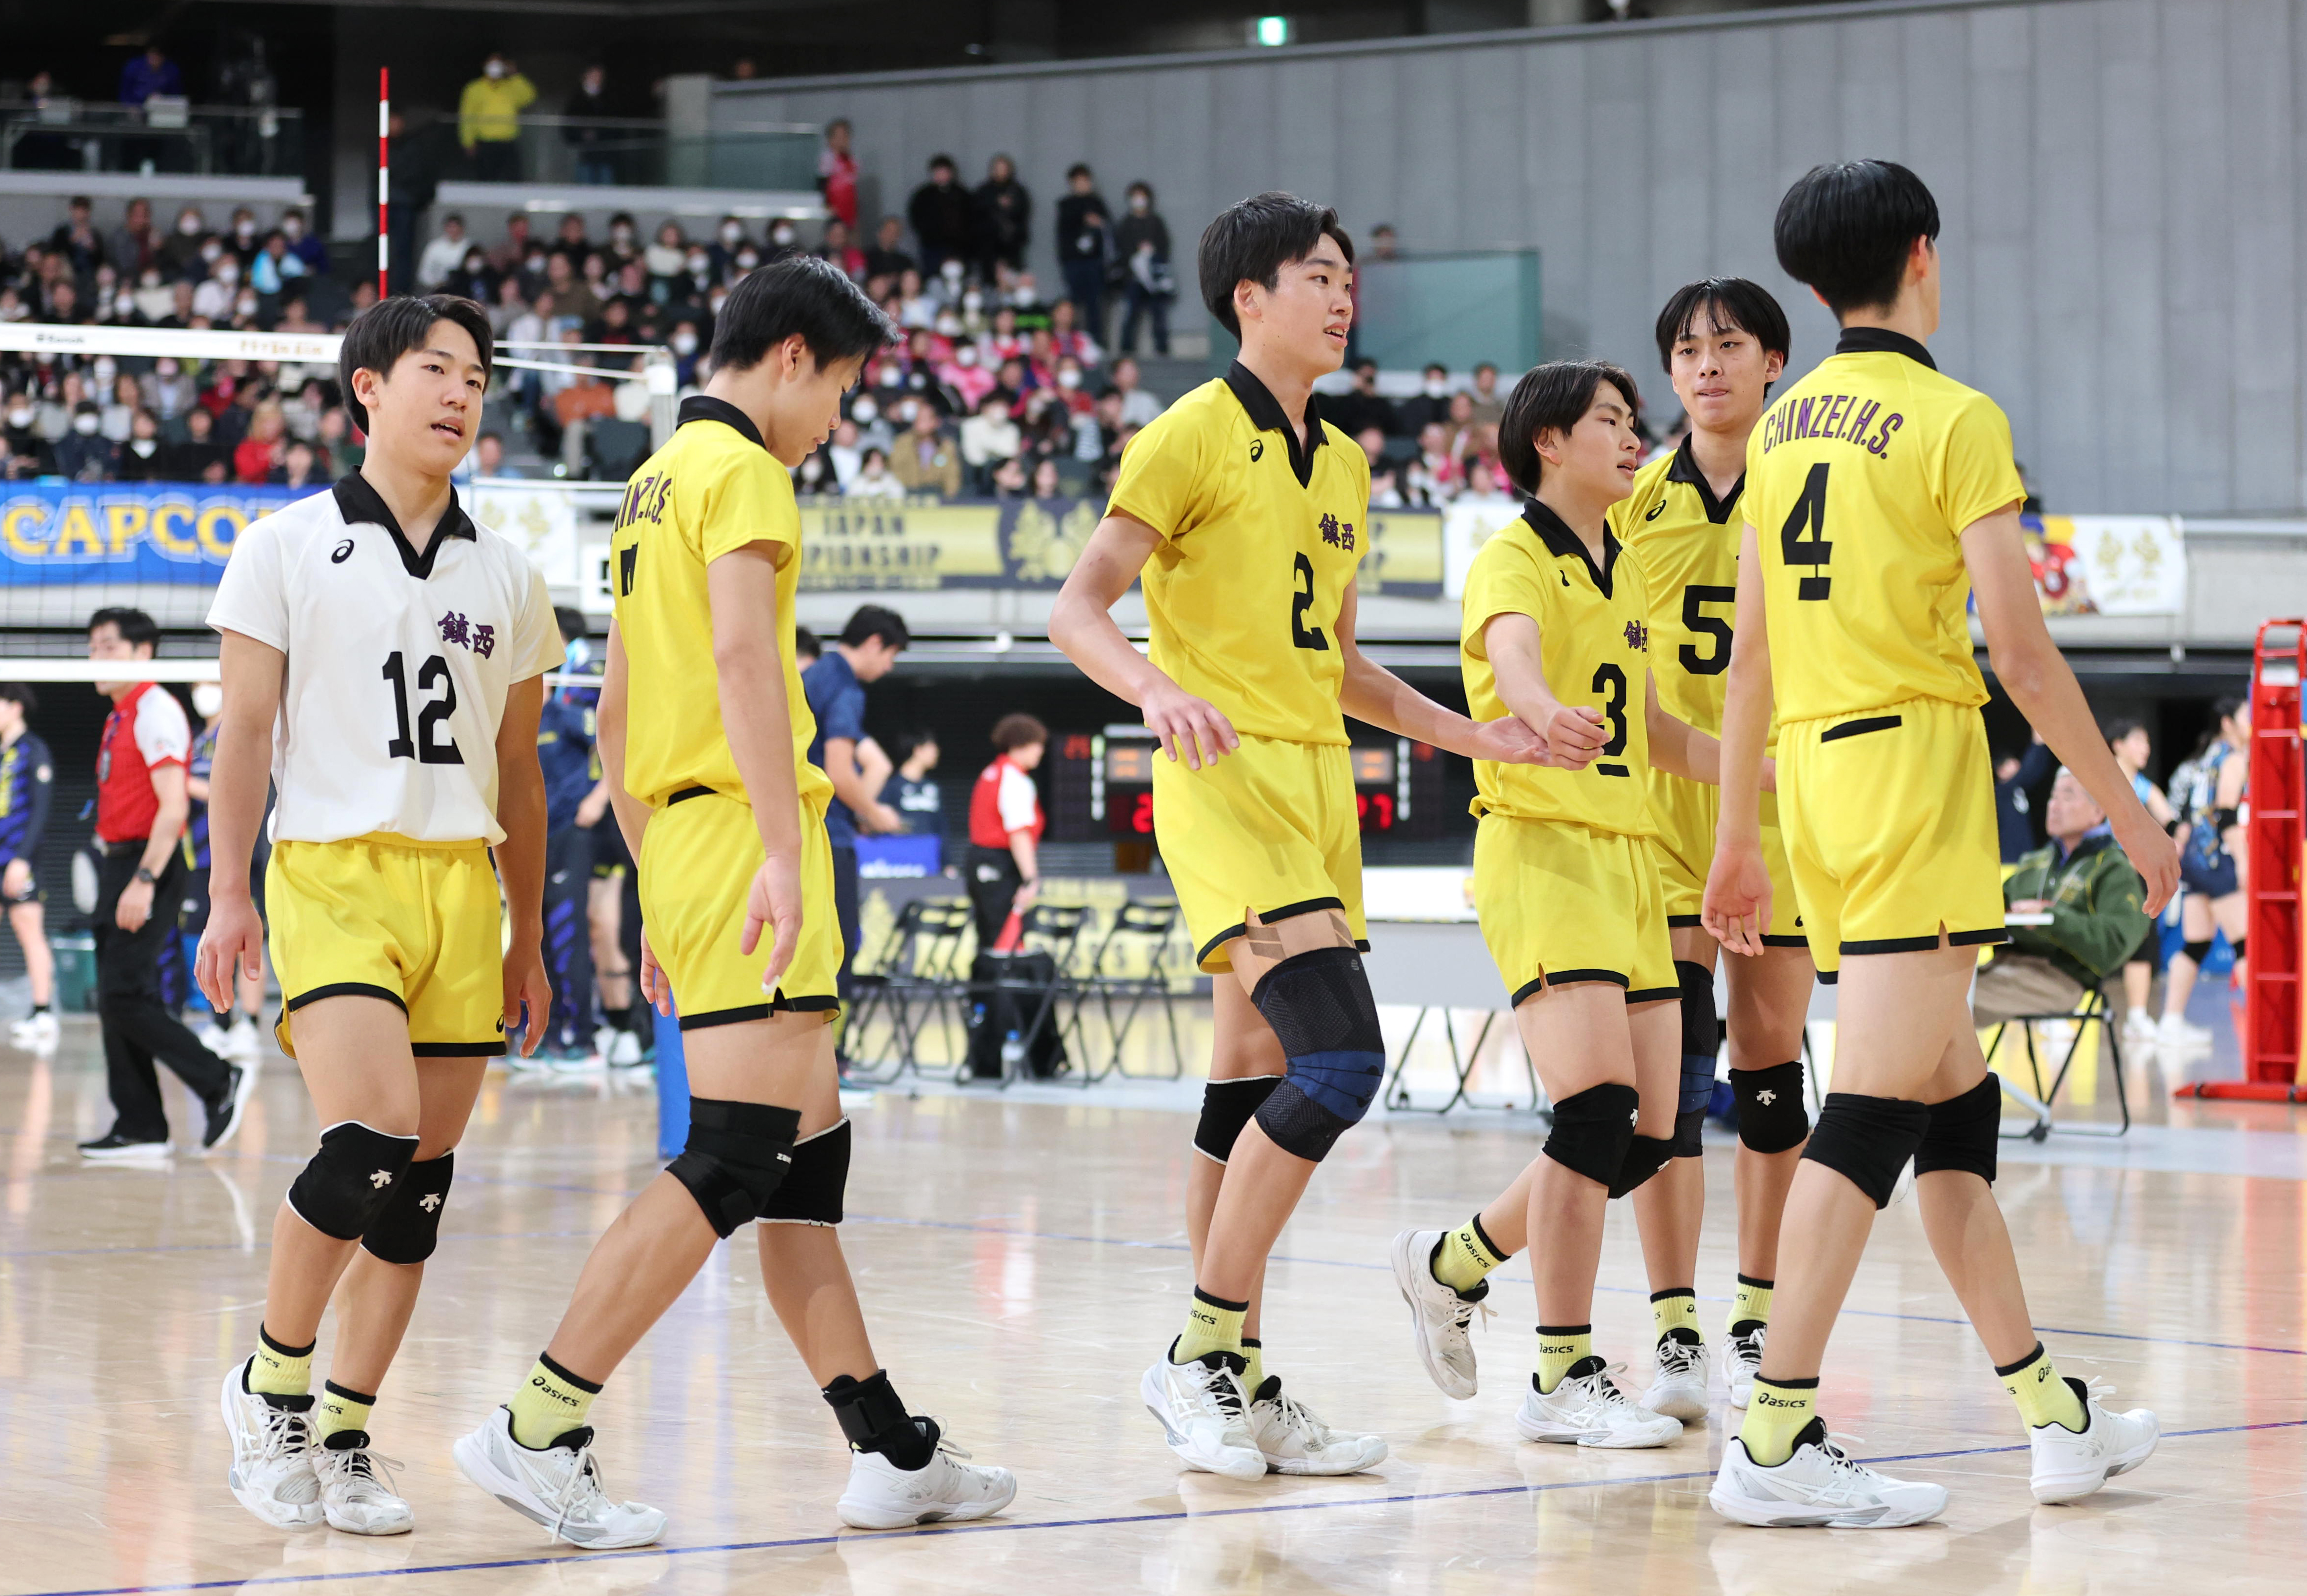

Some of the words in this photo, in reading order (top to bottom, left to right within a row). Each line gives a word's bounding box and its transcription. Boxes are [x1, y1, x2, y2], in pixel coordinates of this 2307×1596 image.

[3, 503, 274, 557] CAPCO
[1318, 513, 1355, 554] 鎮西
[1781, 462, 1833, 600] 4
[807, 543, 940, 567] PIONSHIP
[1291, 551, 1330, 651] 2
[438, 611, 495, 659] 鎮西
[1678, 585, 1736, 676] 5
[382, 651, 465, 765] 12
[1592, 663, 1627, 757] 3
[1465, 1242, 1491, 1268] asics
[1543, 1345, 1574, 1354] asics
[542, 1384, 580, 1407] asics
[1767, 1397, 1807, 1408] asics
